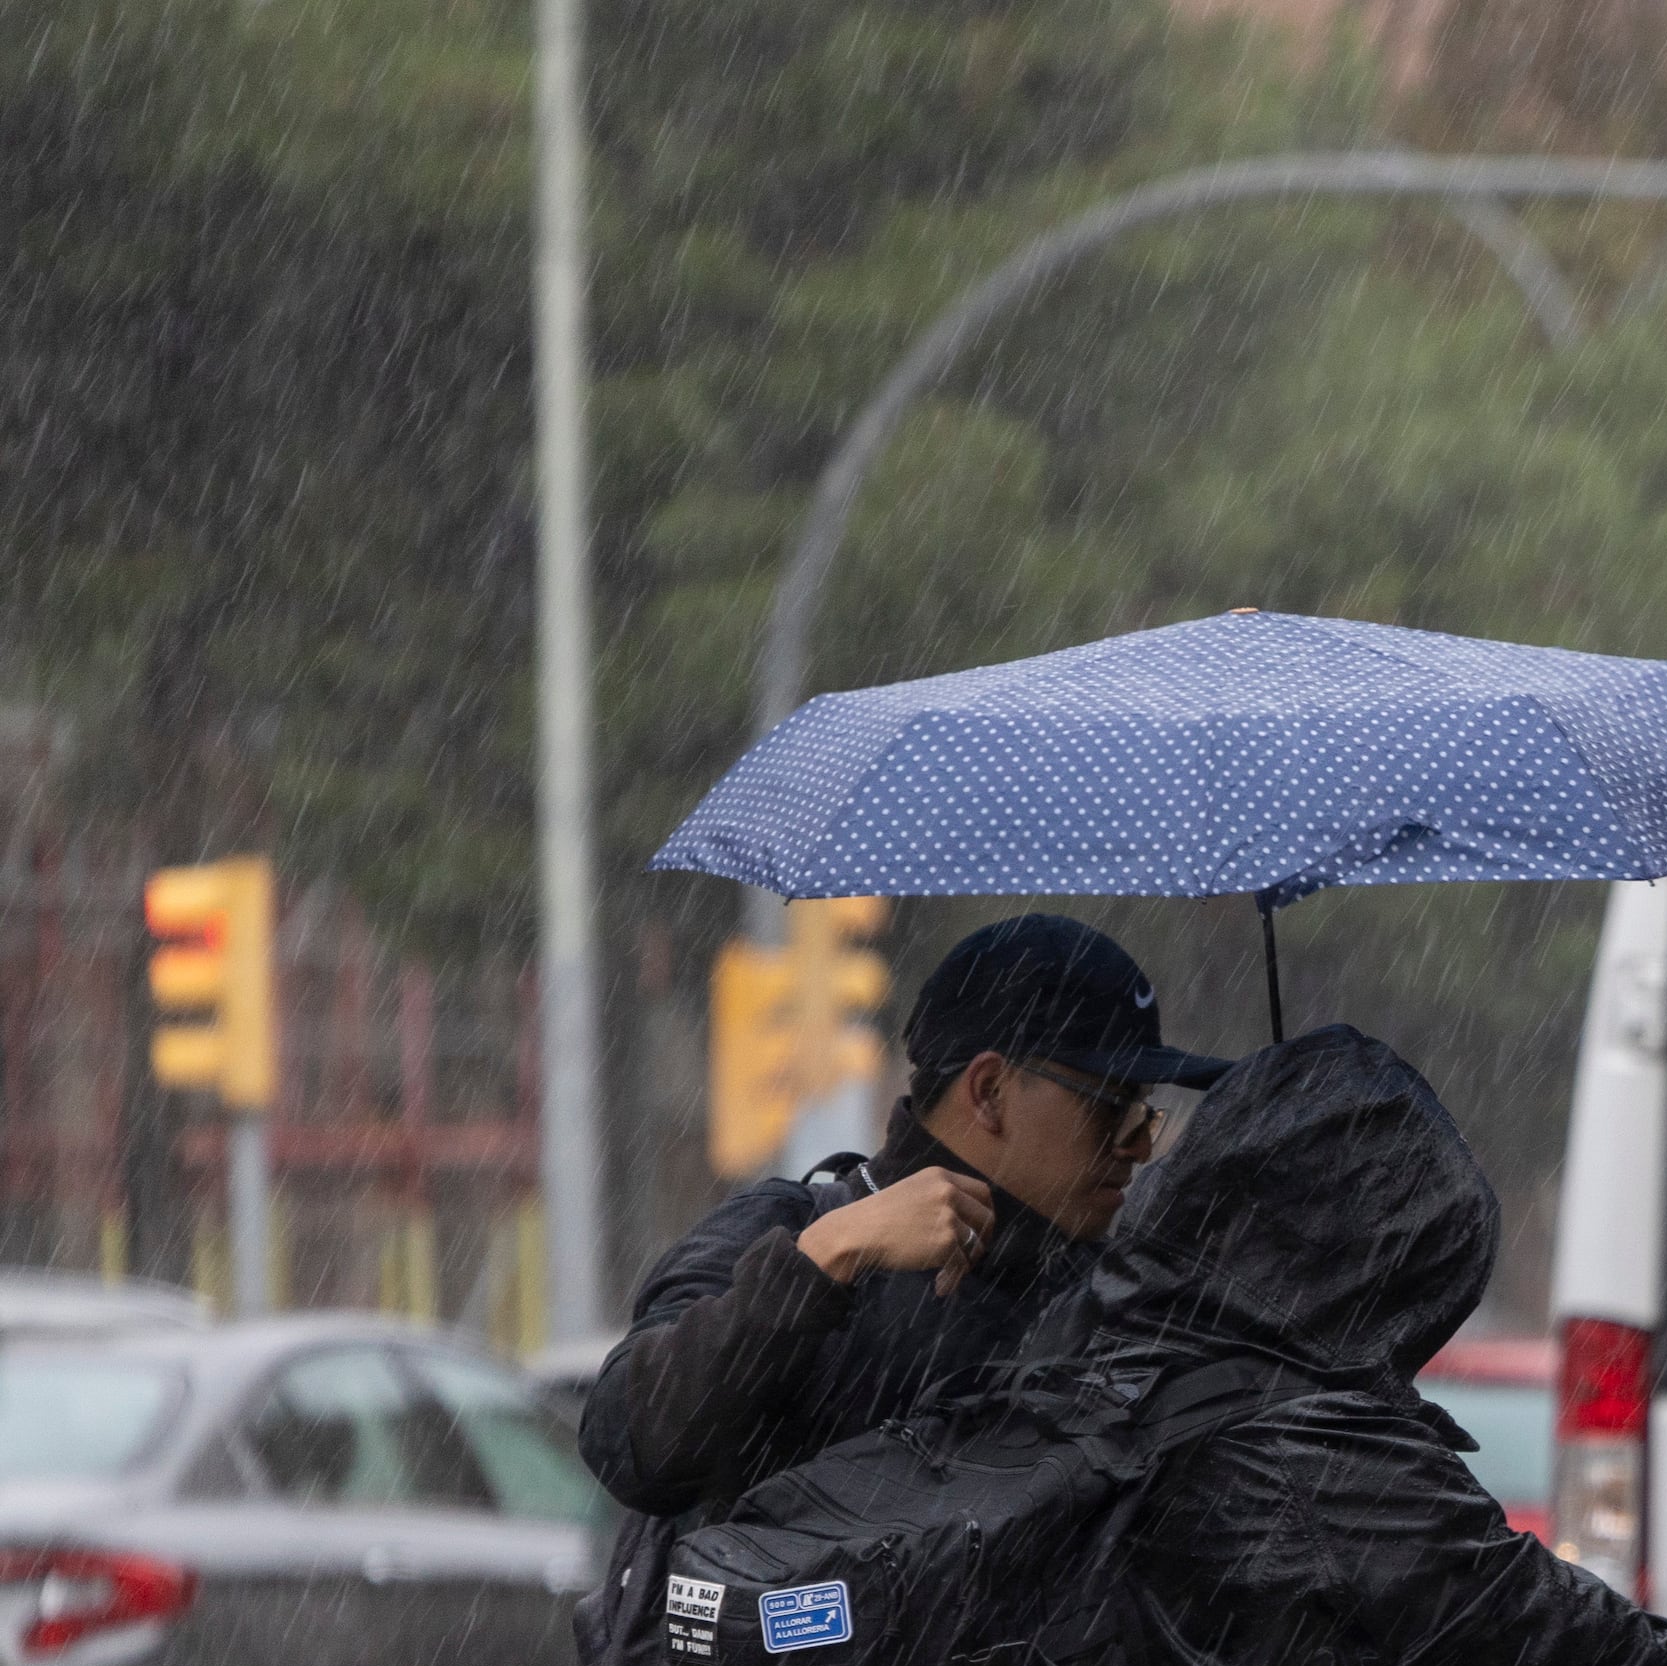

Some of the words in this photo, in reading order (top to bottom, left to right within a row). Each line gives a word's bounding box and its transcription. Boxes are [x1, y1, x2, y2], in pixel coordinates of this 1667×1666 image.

[671, 1583, 683, 1595] I'M
[687, 1586, 693, 1597] A
[698, 1588, 719, 1601] BAD
[668, 1600, 716, 1619] INFLUENCE
[768, 1600, 786, 1609] 500
[774, 1621, 782, 1629] A
[781, 1616, 812, 1628] LLORAR
[775, 1631, 783, 1639] A
[783, 1630, 793, 1638] LA
